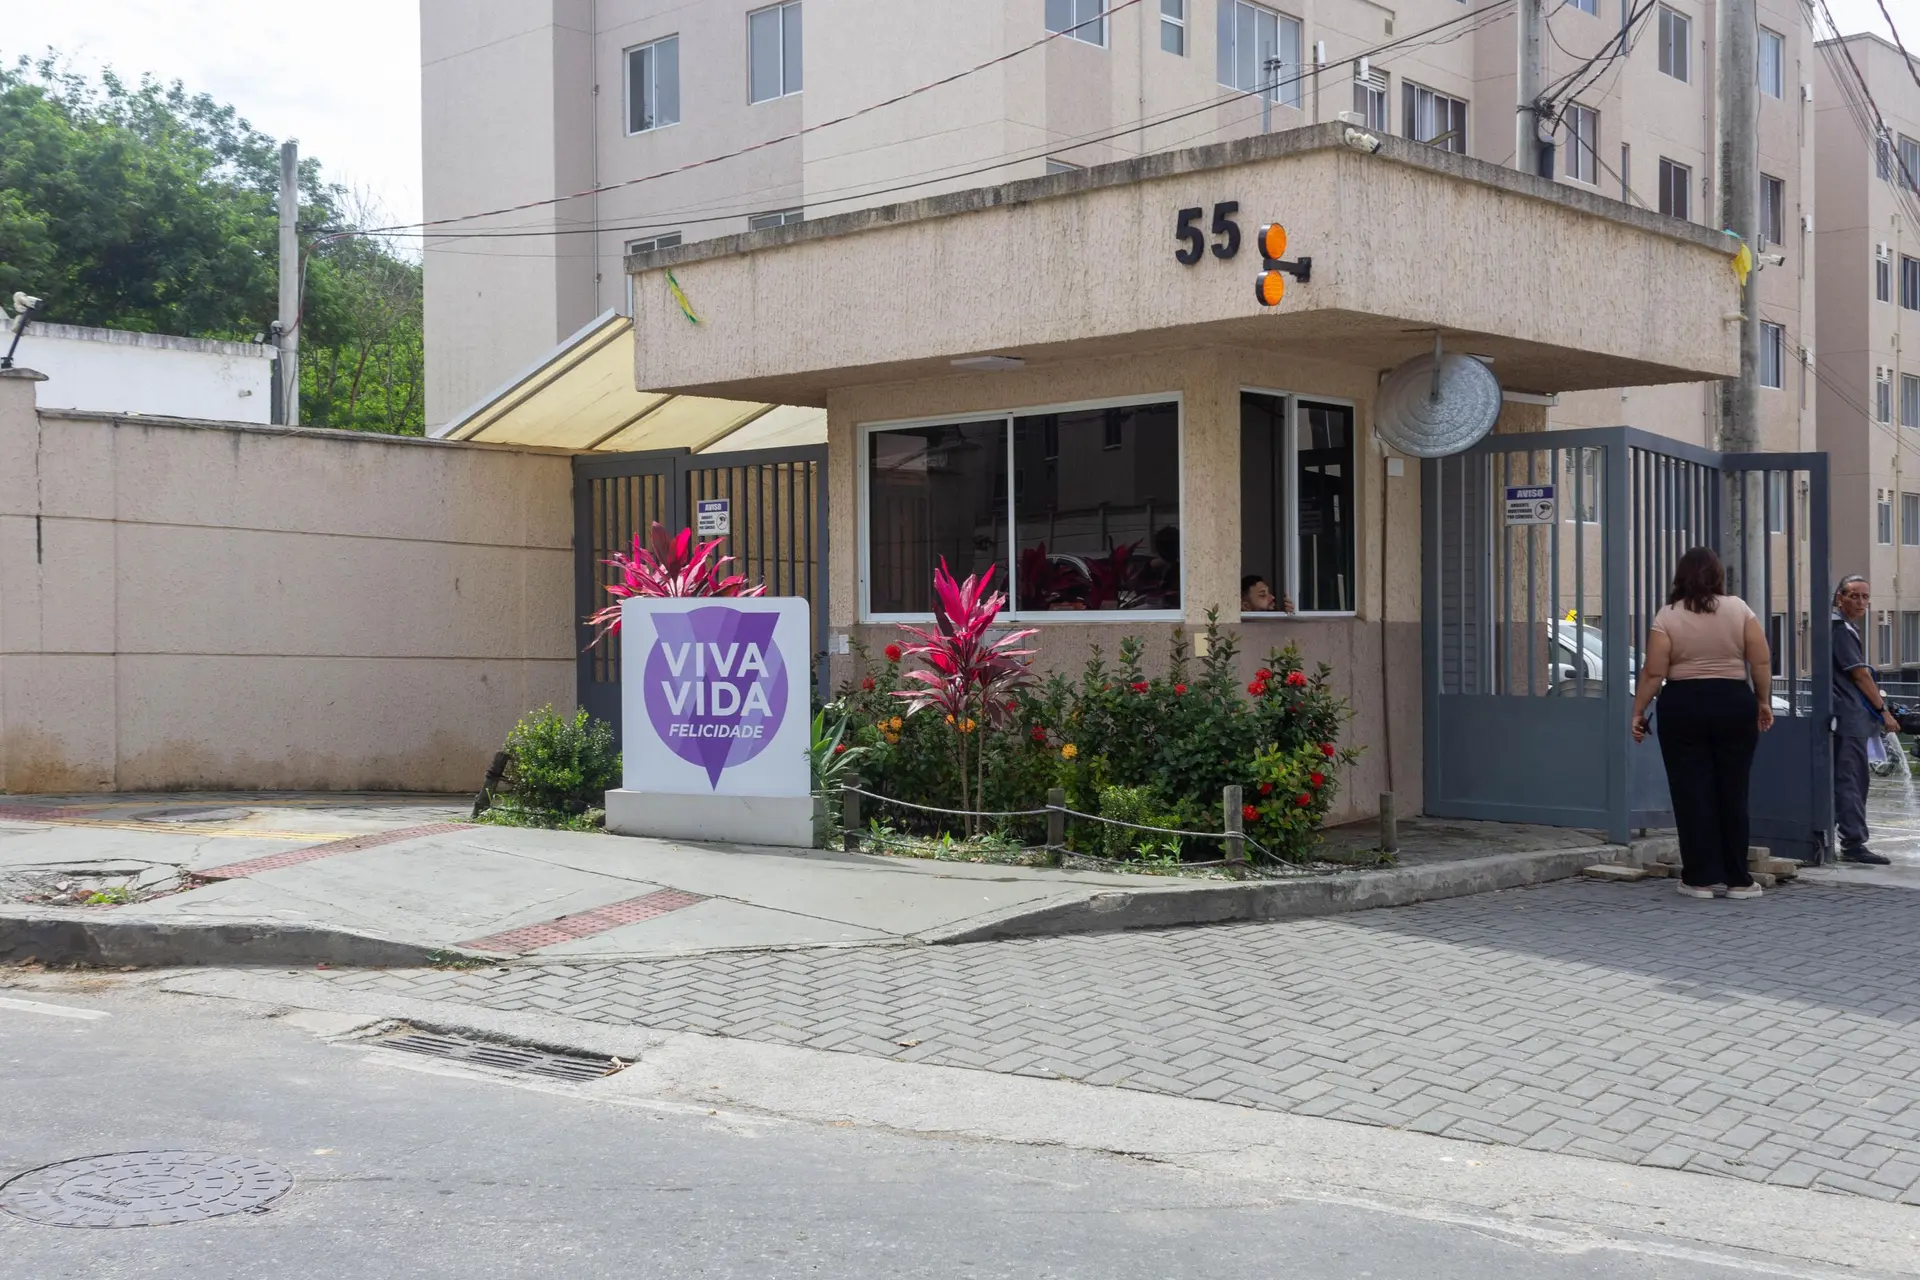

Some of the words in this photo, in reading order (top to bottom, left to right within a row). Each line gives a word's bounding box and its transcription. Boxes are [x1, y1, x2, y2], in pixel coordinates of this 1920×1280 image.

[1175, 201, 1241, 266] 55
[1516, 489, 1544, 498] AVISO
[705, 503, 722, 512] AVISO
[661, 642, 770, 678] VIVA
[661, 681, 773, 717] VIDA
[669, 724, 764, 738] FELICIDADE
